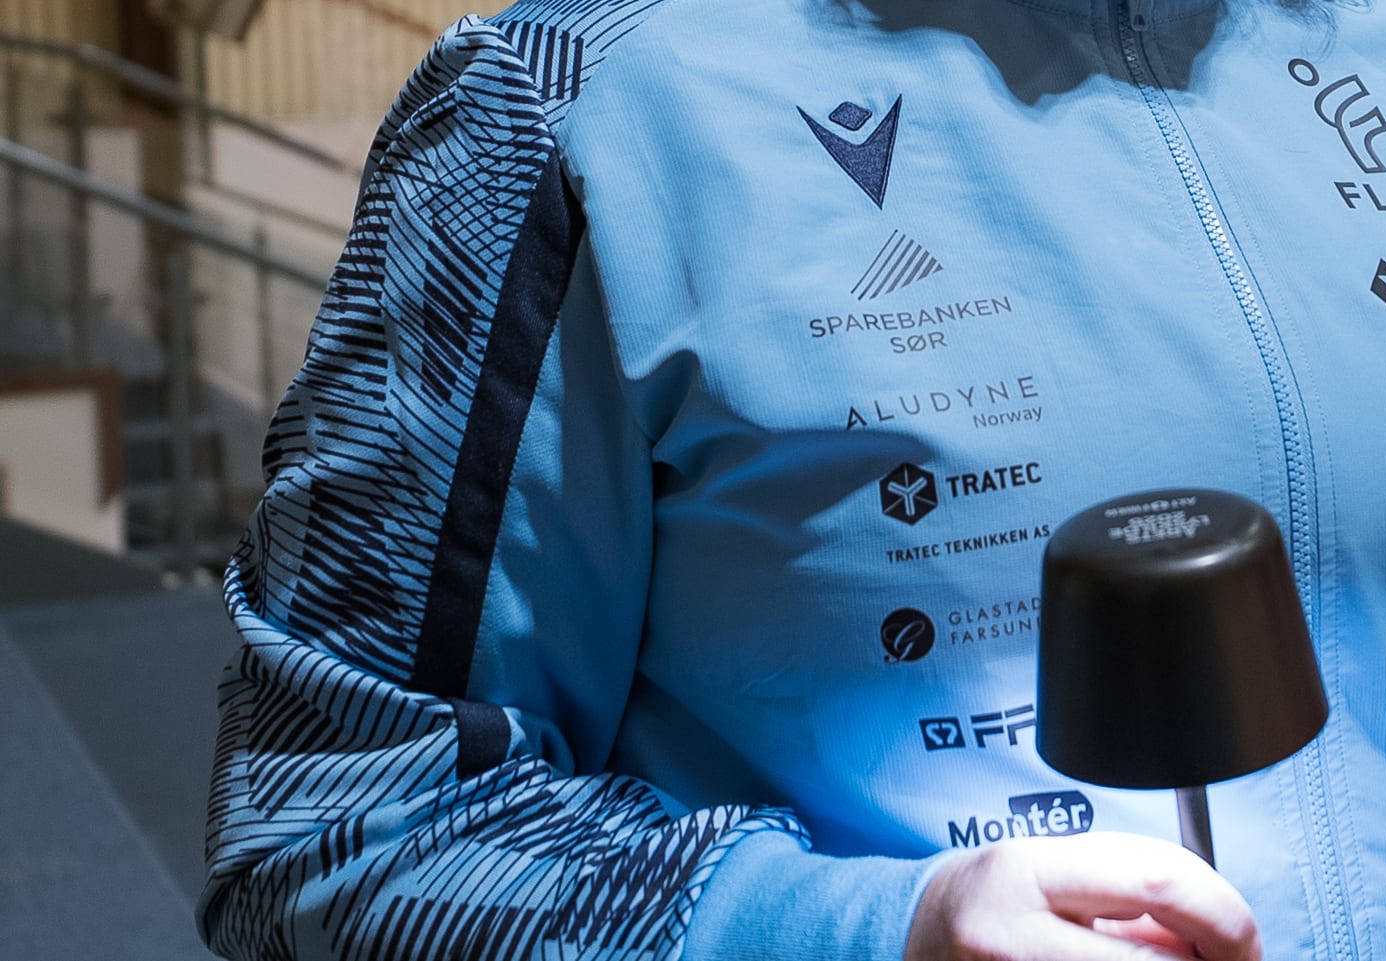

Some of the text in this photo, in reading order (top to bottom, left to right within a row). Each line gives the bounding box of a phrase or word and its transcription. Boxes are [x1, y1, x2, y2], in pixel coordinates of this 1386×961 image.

[809, 295, 1013, 338] SPAREBANKEN
[890, 330, 947, 354] SØR
[846, 375, 1039, 431] ALUDYNE
[972, 406, 1043, 429] Norway
[946, 462, 1042, 498] TRATEC
[886, 524, 1050, 564] TRATEC TEKNIKKEN AS
[950, 617, 1041, 645] FARSUN
[948, 797, 1087, 848] Montér
